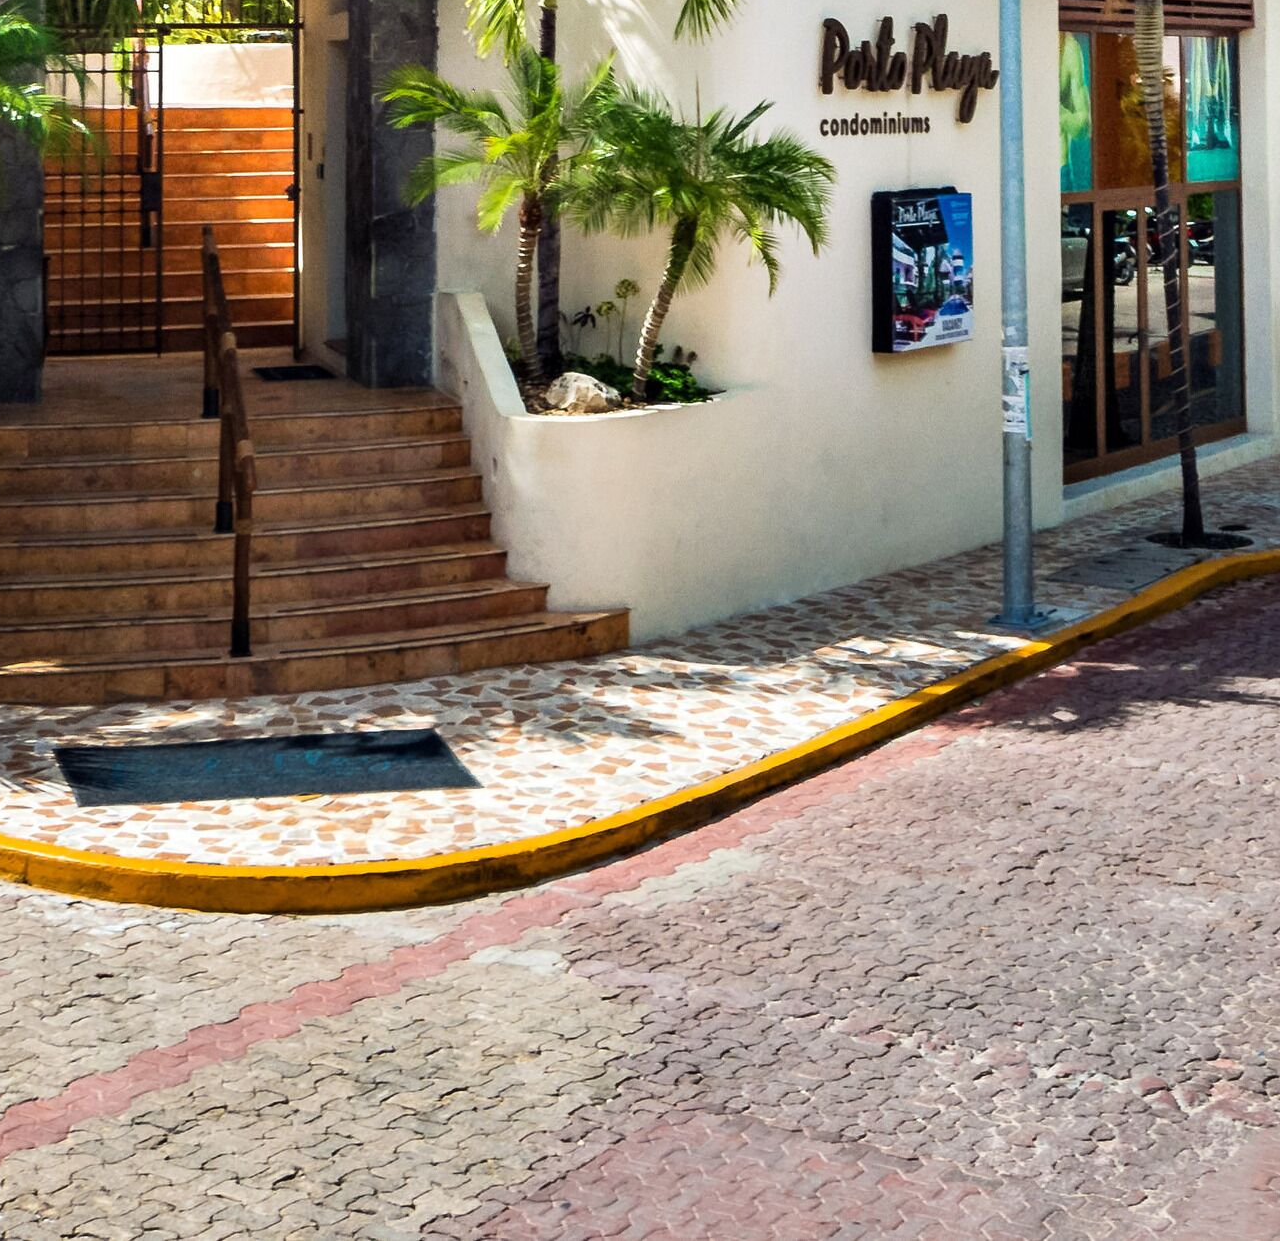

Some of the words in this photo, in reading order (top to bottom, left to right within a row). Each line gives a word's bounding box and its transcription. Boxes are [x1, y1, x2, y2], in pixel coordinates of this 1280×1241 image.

[821, 16, 908, 95] Porto
[911, 14, 1000, 124] Playa
[820, 111, 931, 137] condominiums
